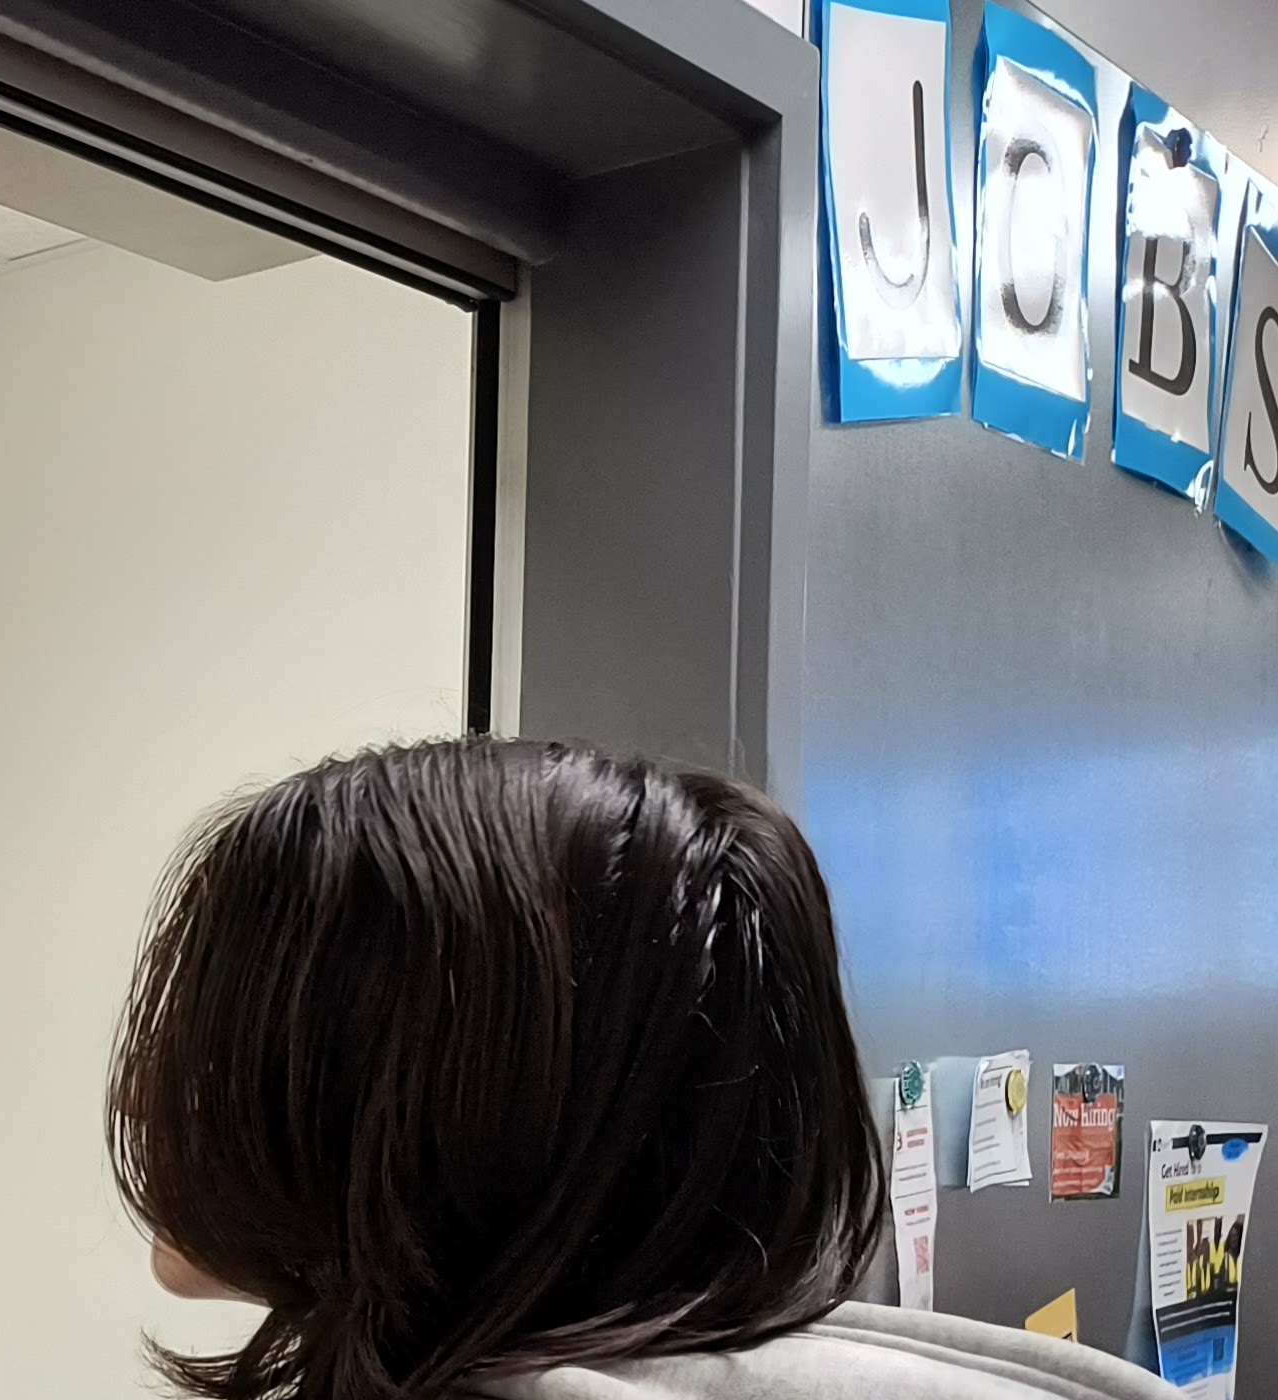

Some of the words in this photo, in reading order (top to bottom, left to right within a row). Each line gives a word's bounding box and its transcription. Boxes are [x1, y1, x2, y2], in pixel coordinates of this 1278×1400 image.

[1053, 1103, 1080, 1128] Now
[1081, 1102, 1116, 1132] Hiring
[1169, 1186, 1184, 1205] Paid
[1184, 1181, 1220, 1203] Internship
